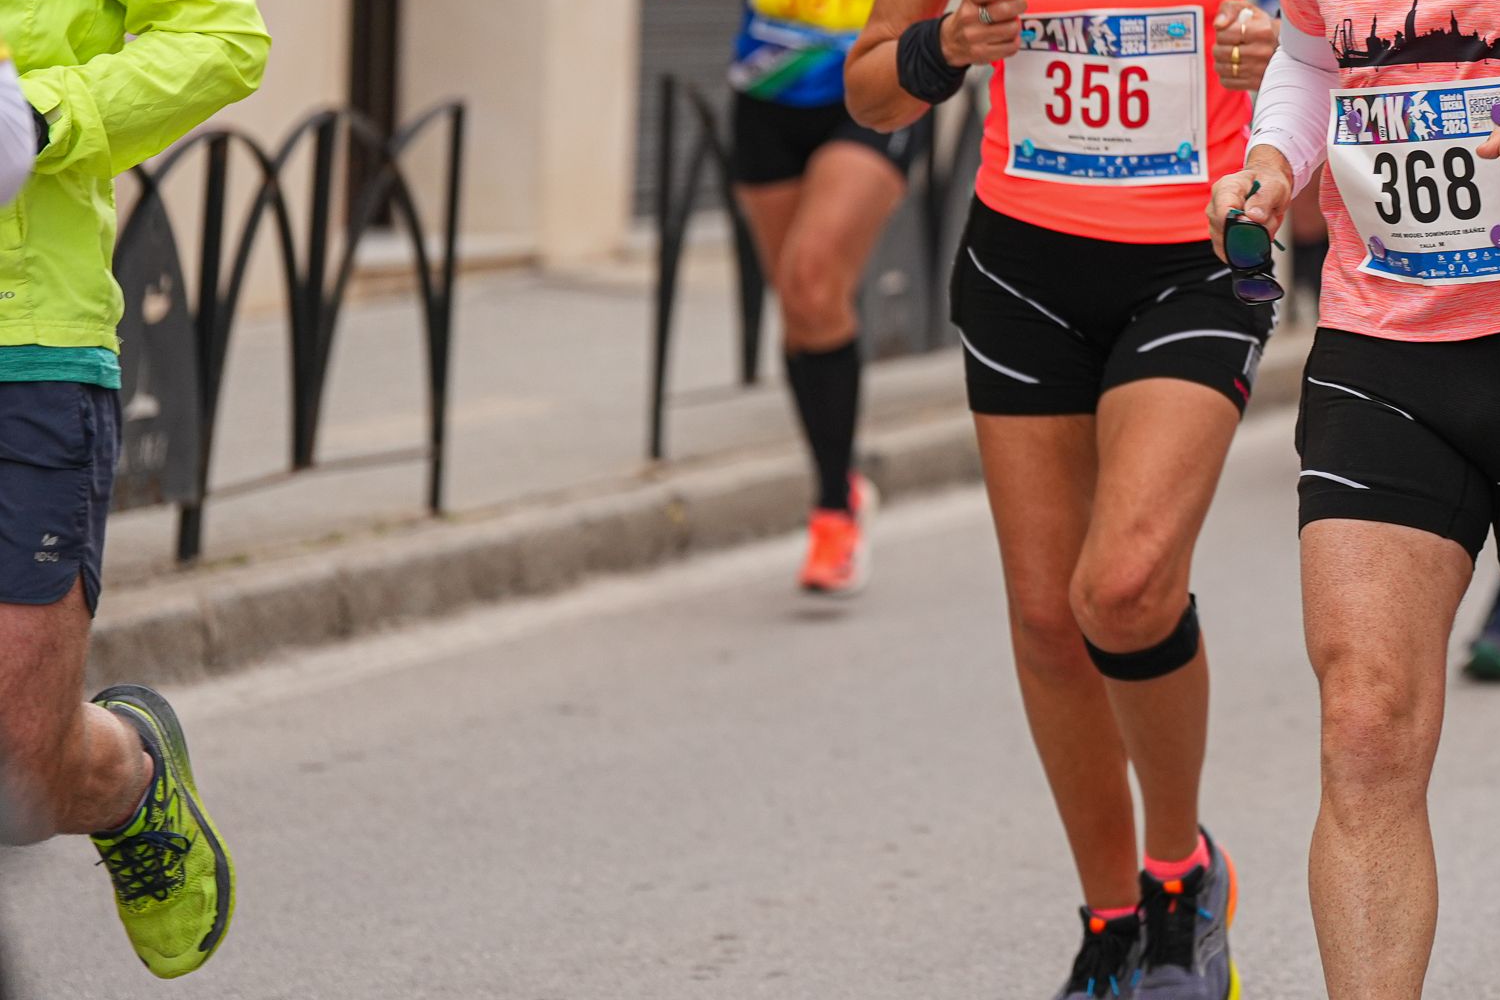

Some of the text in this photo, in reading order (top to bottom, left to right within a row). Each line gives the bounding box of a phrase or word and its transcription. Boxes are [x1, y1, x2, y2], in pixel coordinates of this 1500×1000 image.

[1021, 16, 1088, 53] 21K
[1045, 60, 1149, 129] 356
[1352, 95, 1409, 141] 21K
[1442, 118, 1467, 135] 2026
[1373, 146, 1482, 225] 368
